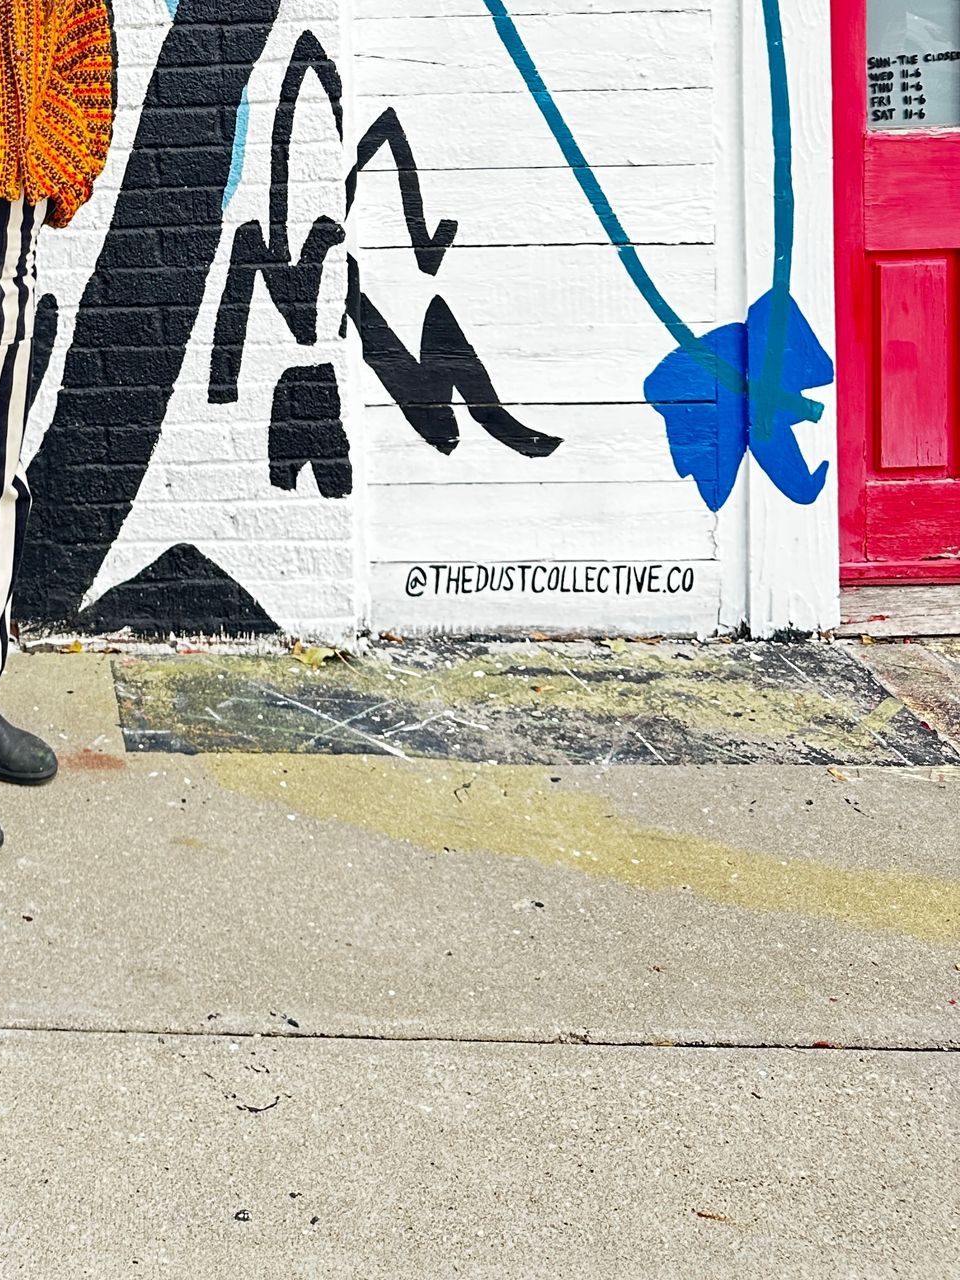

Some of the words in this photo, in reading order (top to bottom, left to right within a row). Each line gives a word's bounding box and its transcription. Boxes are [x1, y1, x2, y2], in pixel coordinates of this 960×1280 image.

[868, 71, 894, 82] WED
[901, 68, 922, 78] 11-6
[869, 83, 893, 94] THU
[901, 82, 923, 93] 11-6
[870, 96, 891, 108] FRI
[903, 94, 926, 105] 11-6
[872, 108, 896, 121] SAT
[903, 108, 926, 120] 11-6
[405, 565, 695, 597] @THEDUSTCOLLECTIVE.CO
